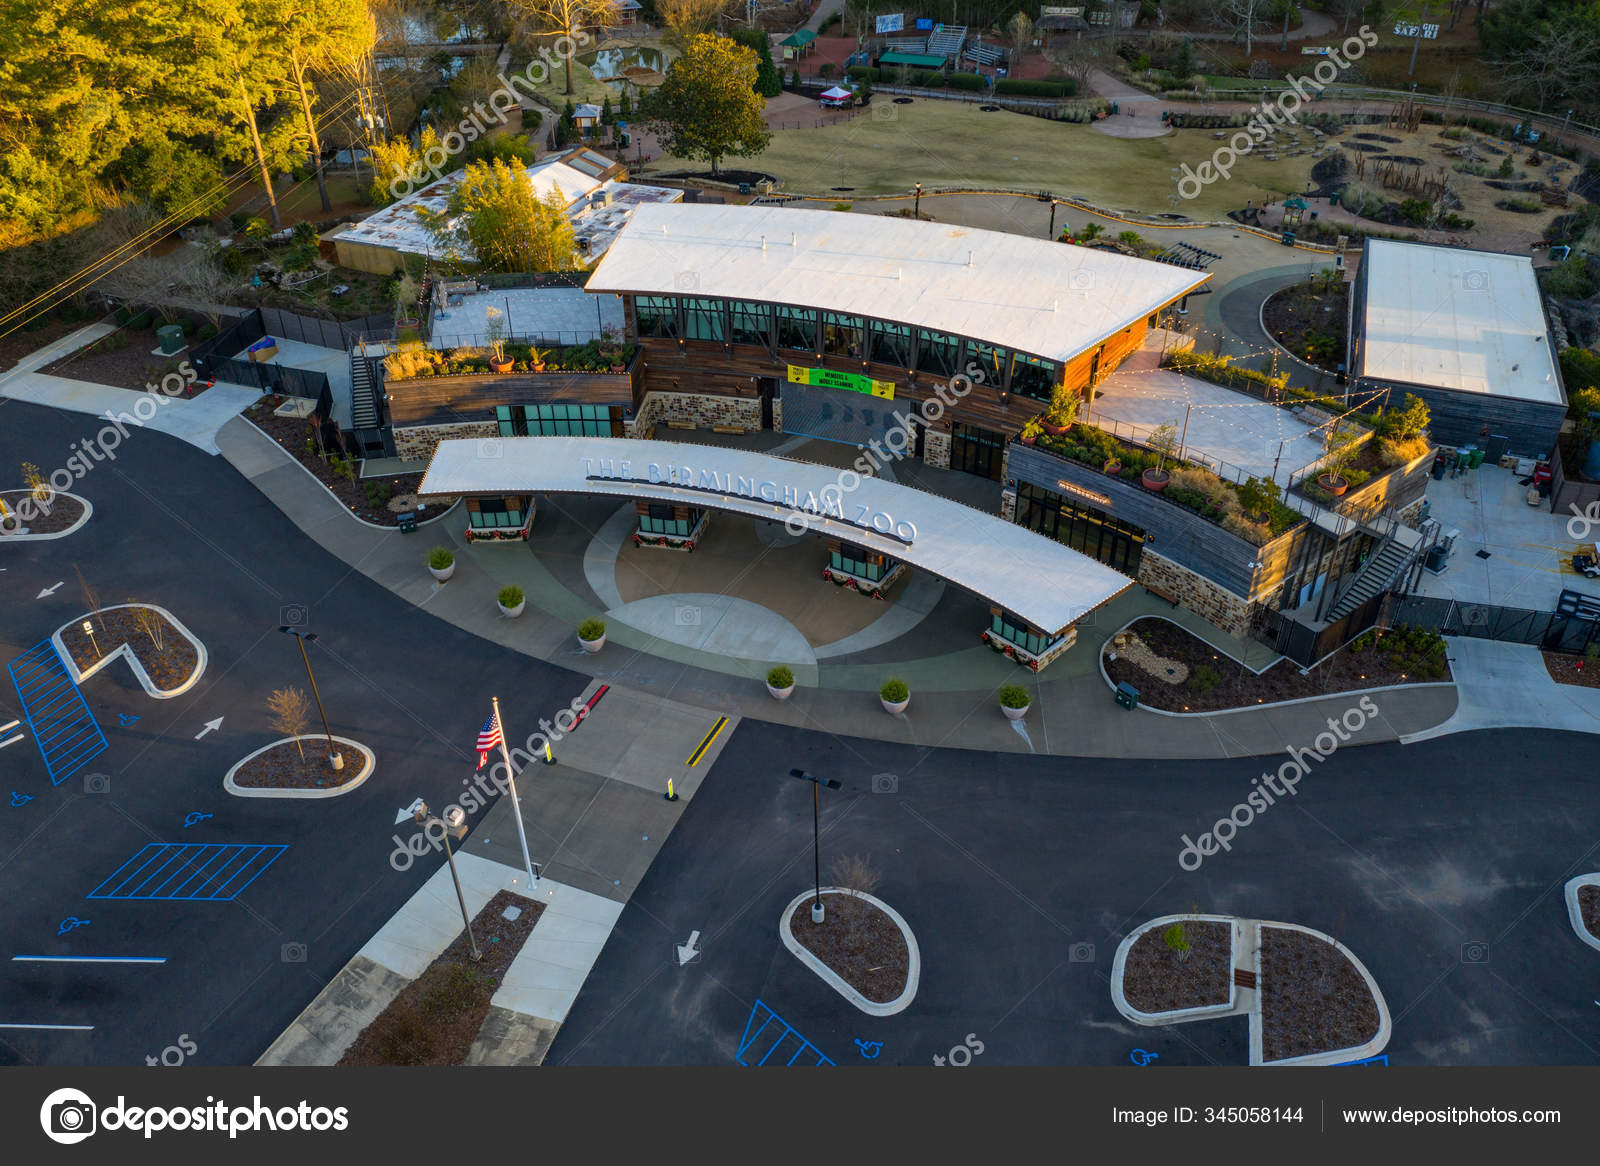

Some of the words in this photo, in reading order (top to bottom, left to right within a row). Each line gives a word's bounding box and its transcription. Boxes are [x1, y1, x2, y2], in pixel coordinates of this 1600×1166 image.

[581, 457, 632, 480] THE
[648, 462, 845, 520] BIRMINGHAM
[855, 503, 918, 542] ZOO
